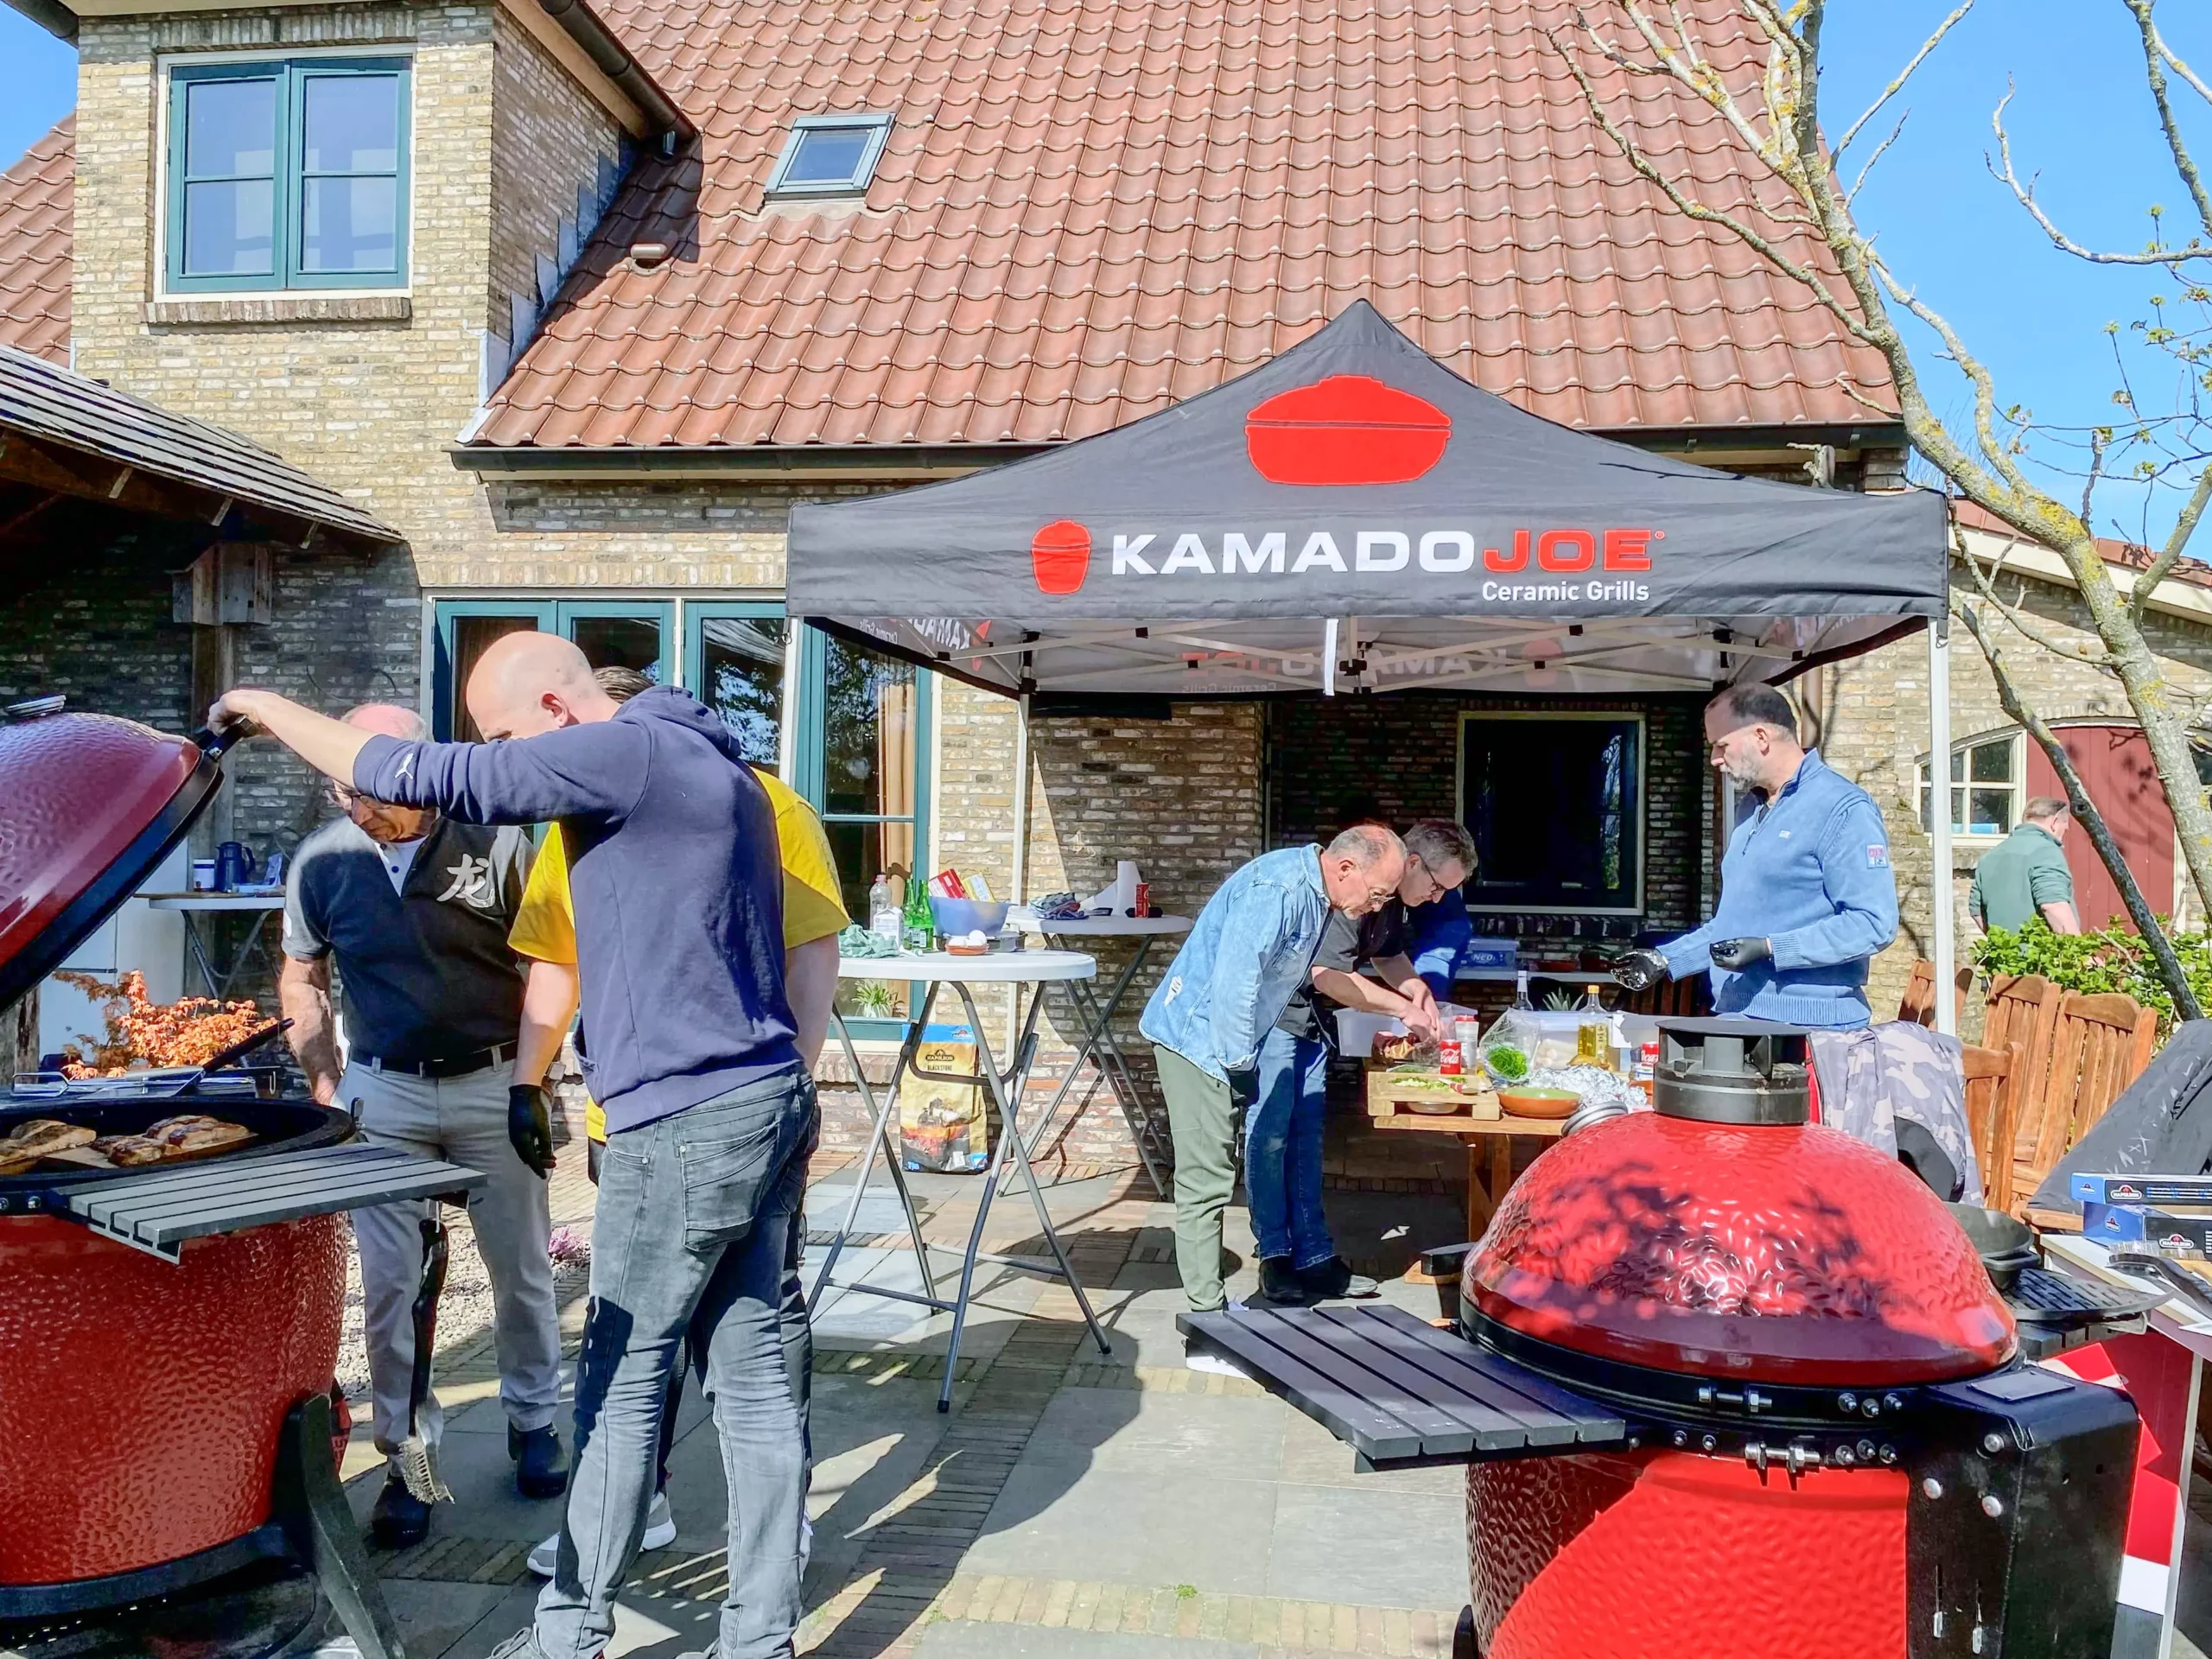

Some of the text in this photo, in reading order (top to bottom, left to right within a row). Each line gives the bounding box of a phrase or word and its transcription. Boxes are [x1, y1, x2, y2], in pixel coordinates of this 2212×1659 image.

[1111, 529, 1652, 575] KAMADO JOE
[1482, 580, 1650, 602] Ceramic Grills
[436, 853, 496, 908] 龙
